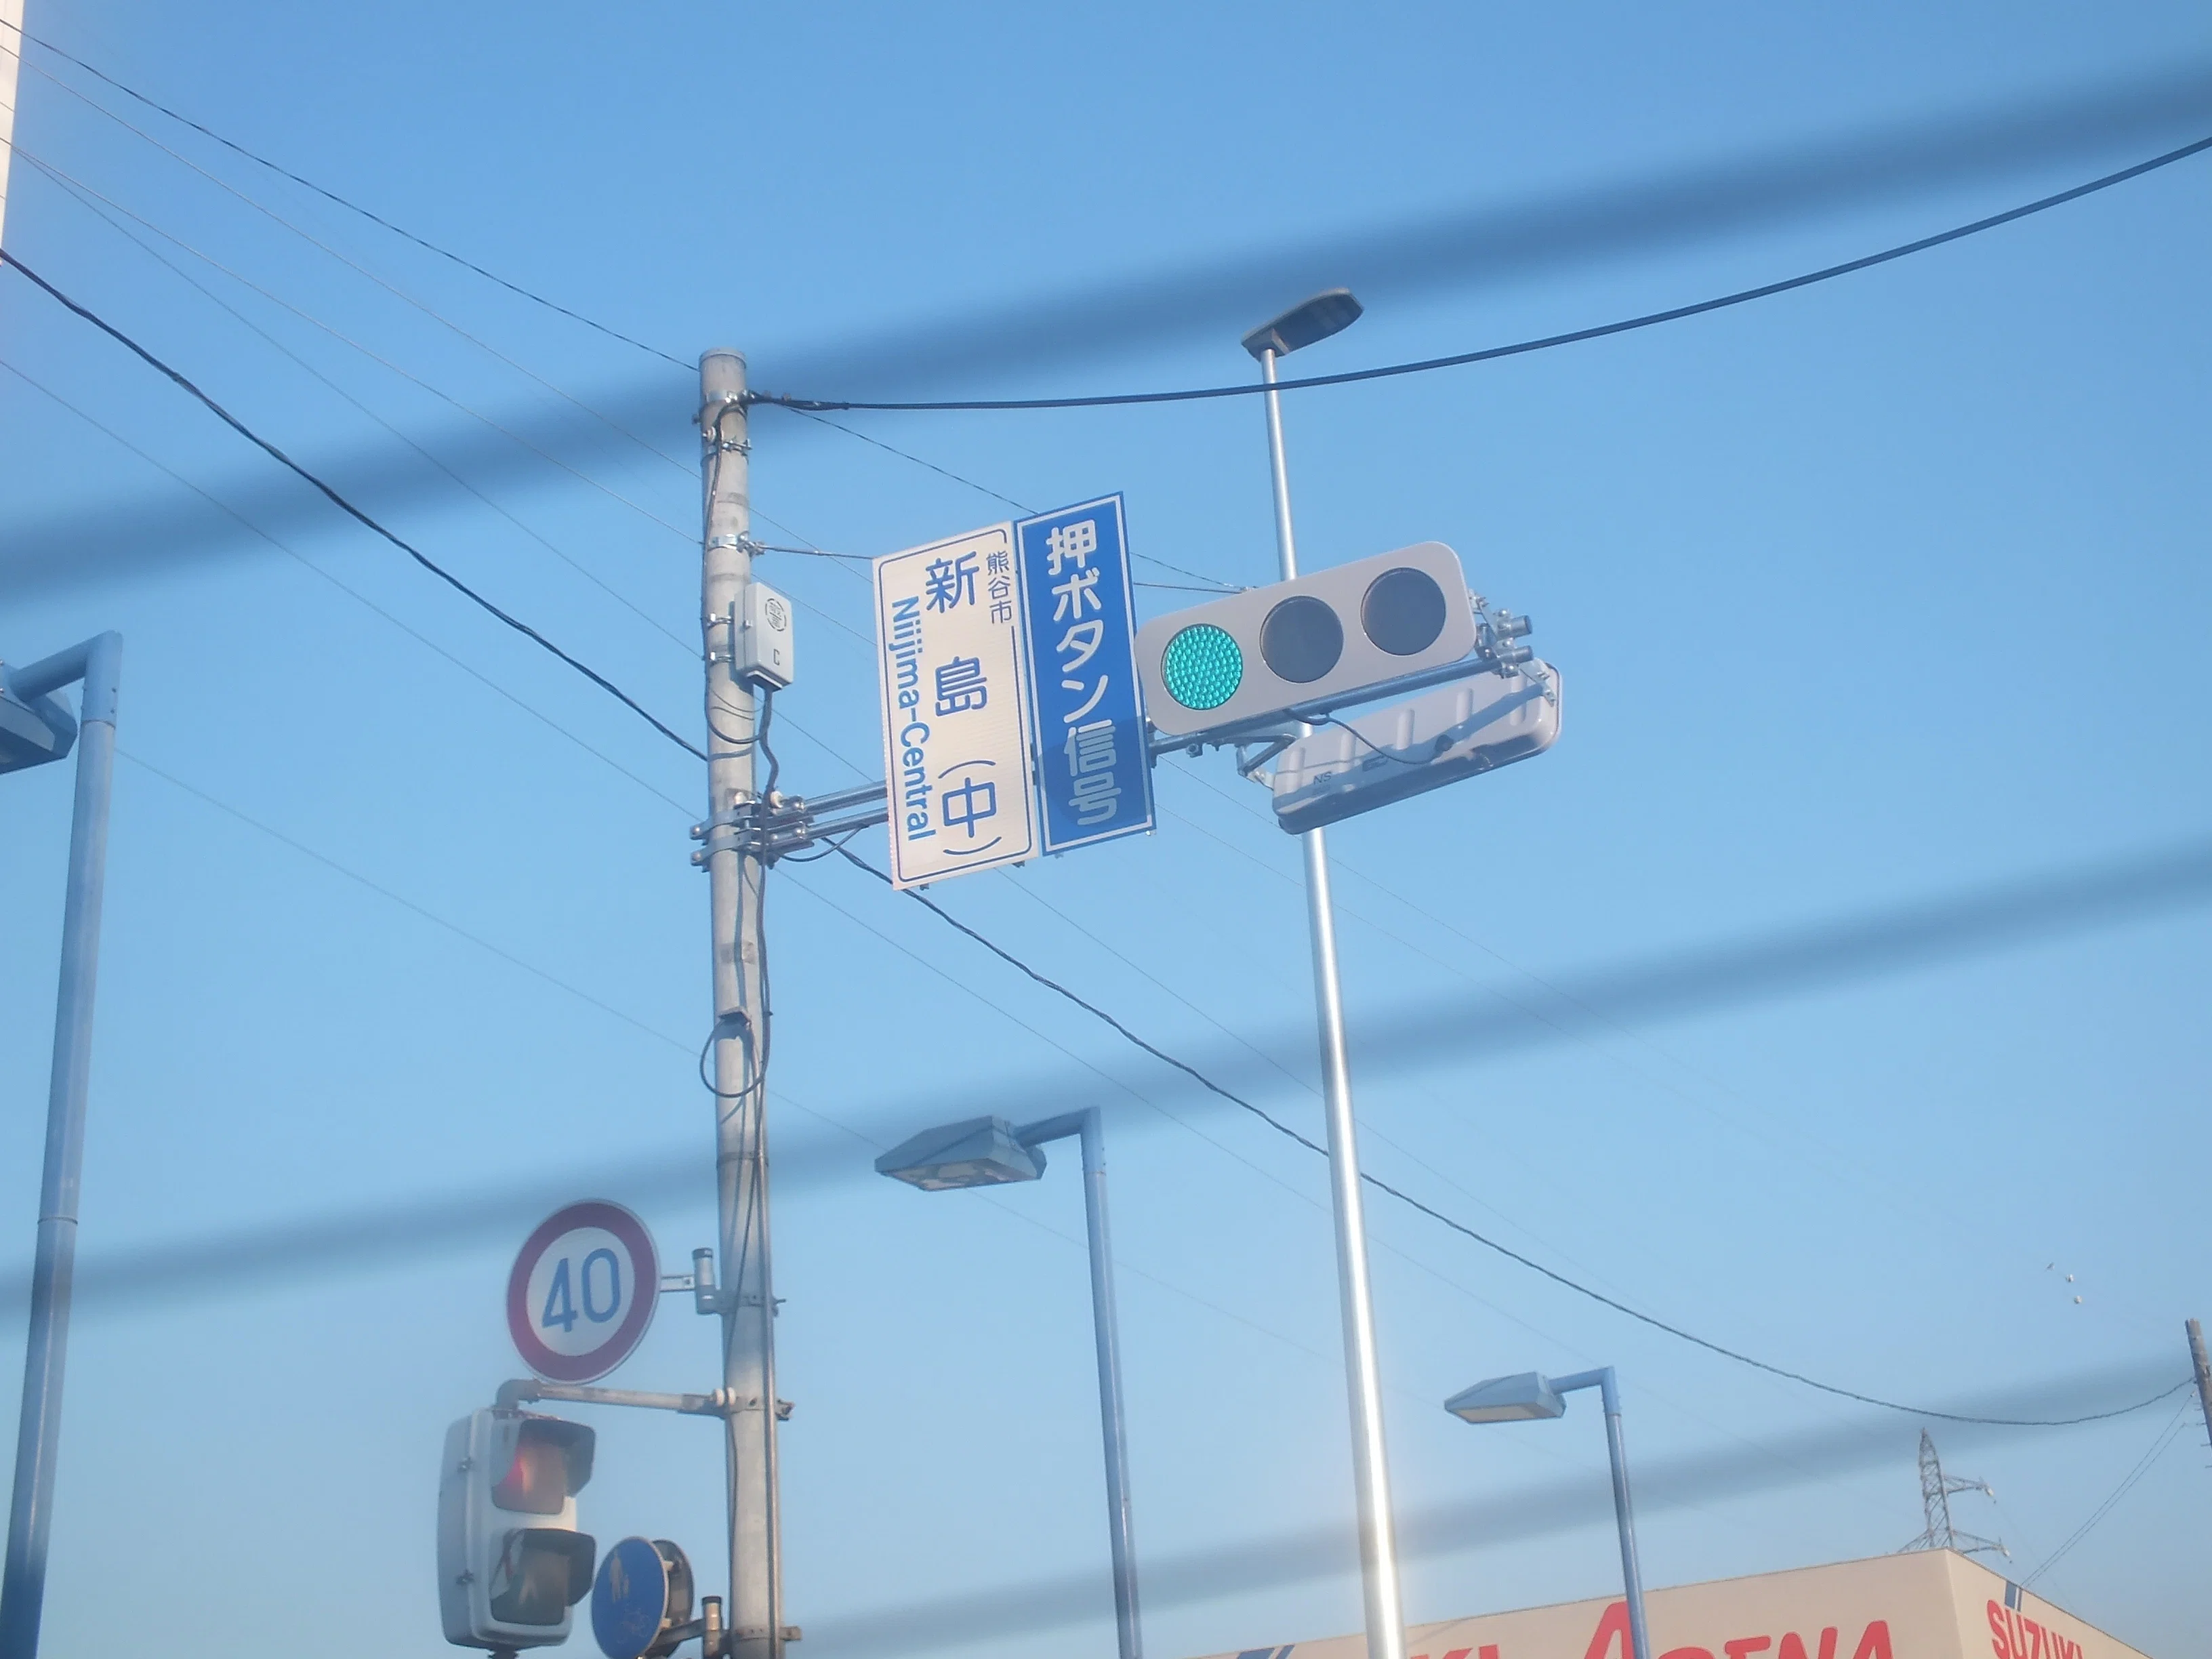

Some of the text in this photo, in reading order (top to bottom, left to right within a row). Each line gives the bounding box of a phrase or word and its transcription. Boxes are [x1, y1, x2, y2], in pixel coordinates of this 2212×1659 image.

[985, 550, 1012, 625] 熊谷市
[889, 596, 938, 841] Niijima-Central
[1046, 519, 1122, 826] 押ボタン信号
[542, 1248, 620, 1332] 40
